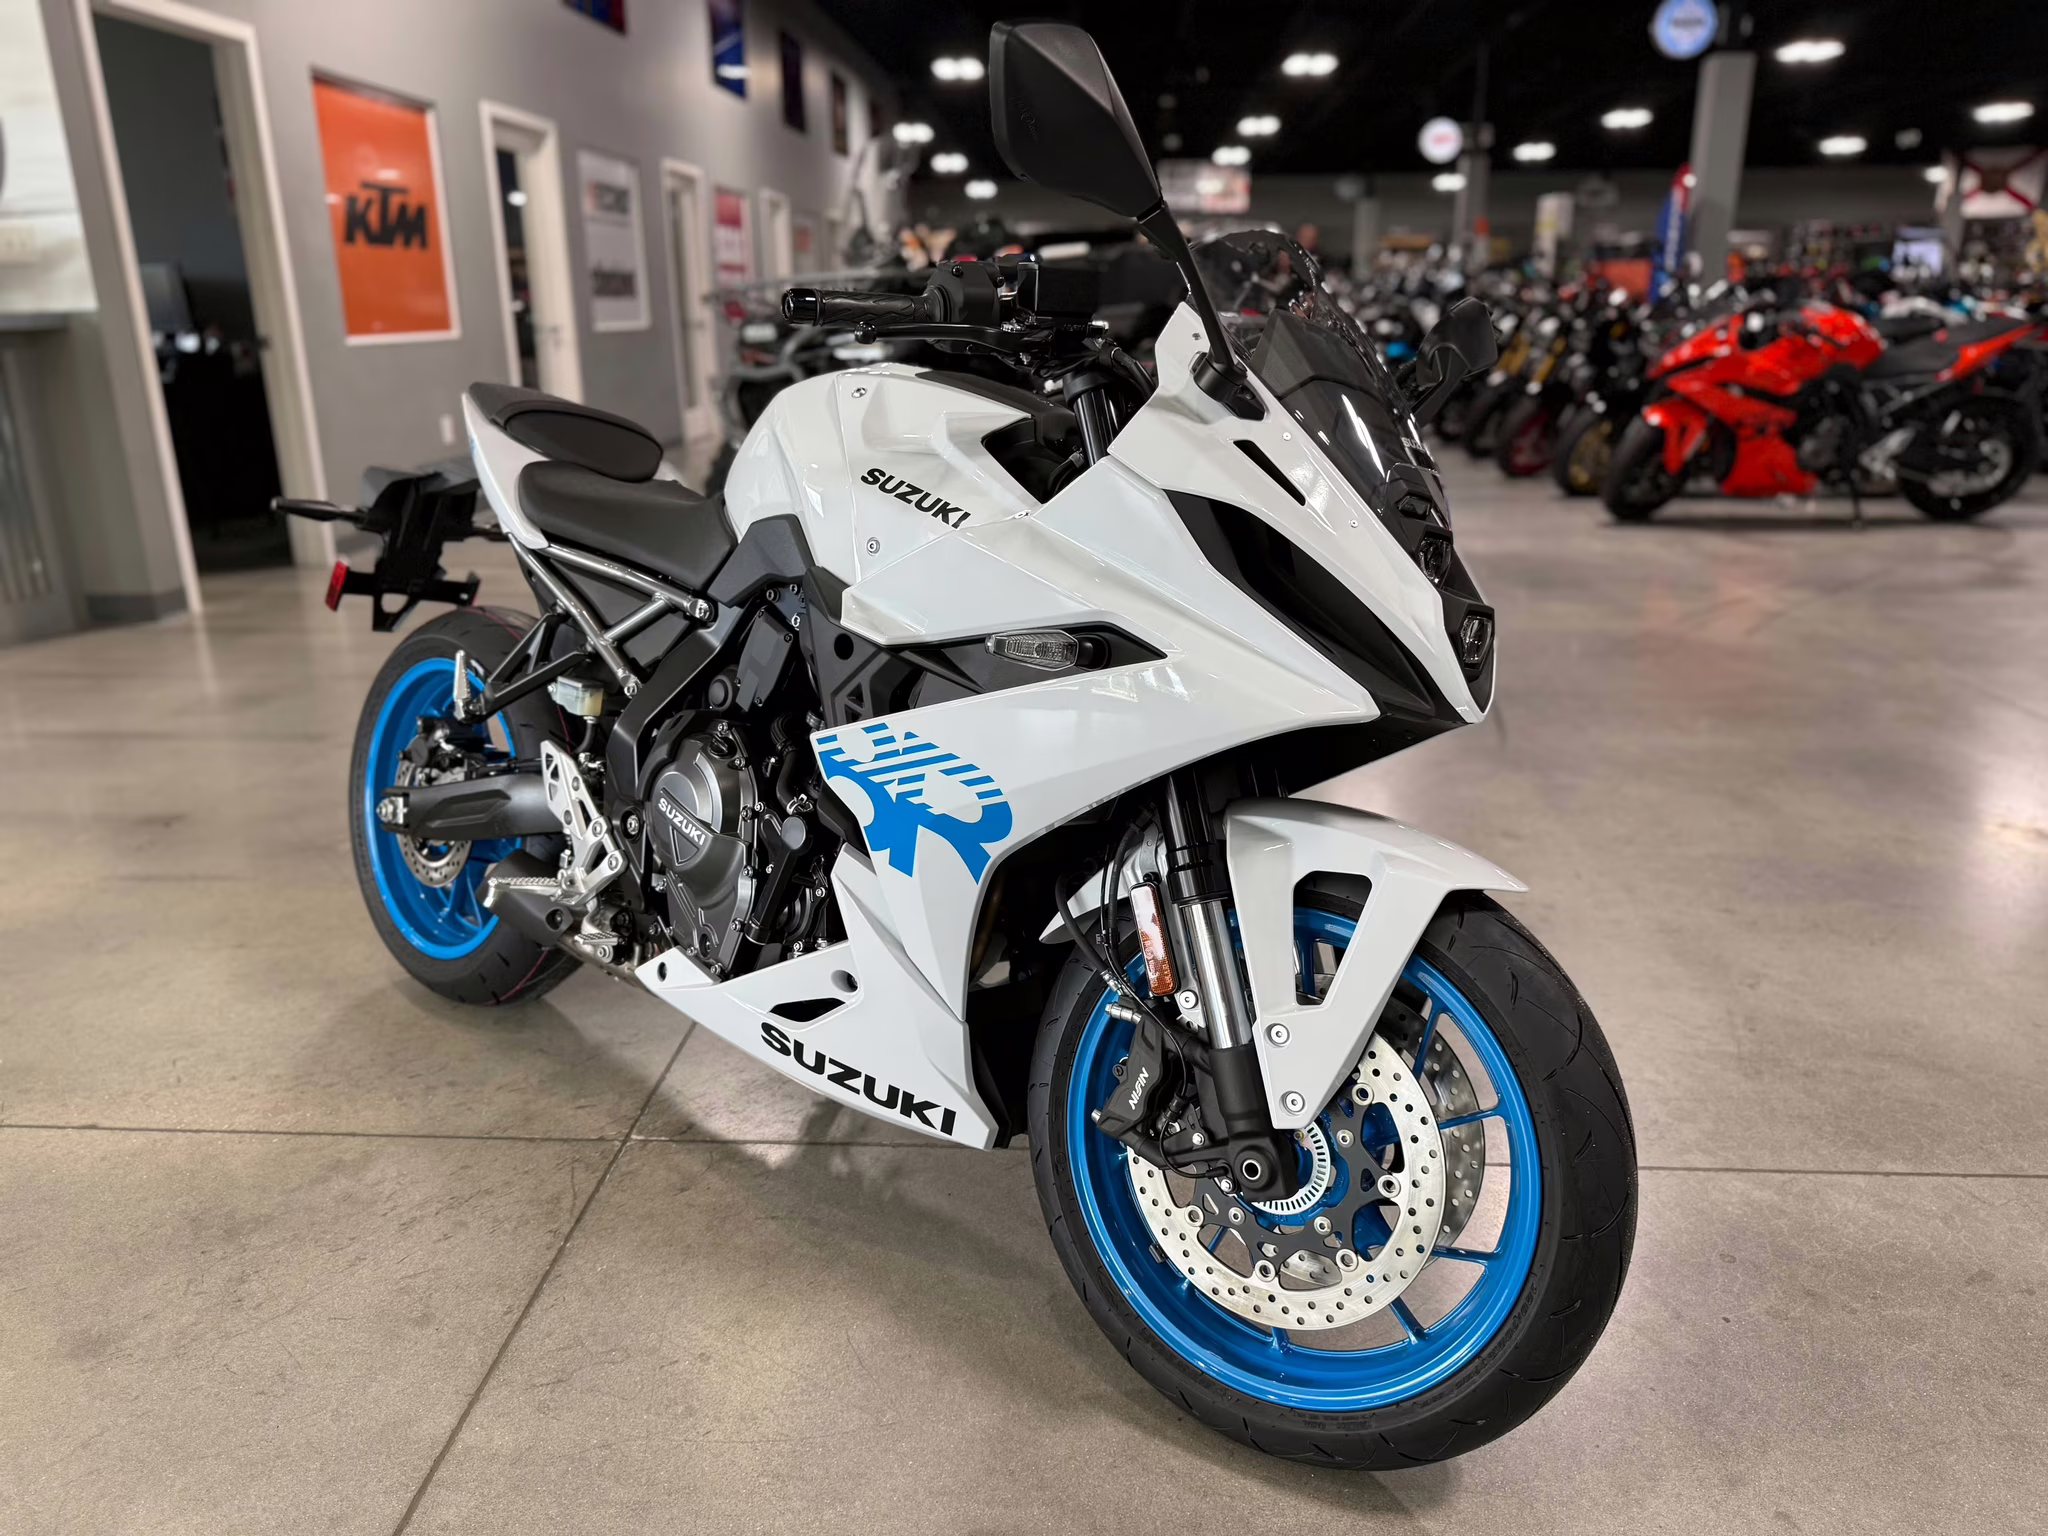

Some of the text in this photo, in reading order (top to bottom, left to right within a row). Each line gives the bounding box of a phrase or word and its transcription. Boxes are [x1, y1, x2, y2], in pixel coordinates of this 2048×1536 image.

[344, 183, 428, 249] KTM
[860, 468, 971, 530] SUZUKI
[658, 797, 706, 846] SUZUKI
[761, 1021, 956, 1136] SUZUKI
[1128, 1066, 1149, 1111] NISSIN
